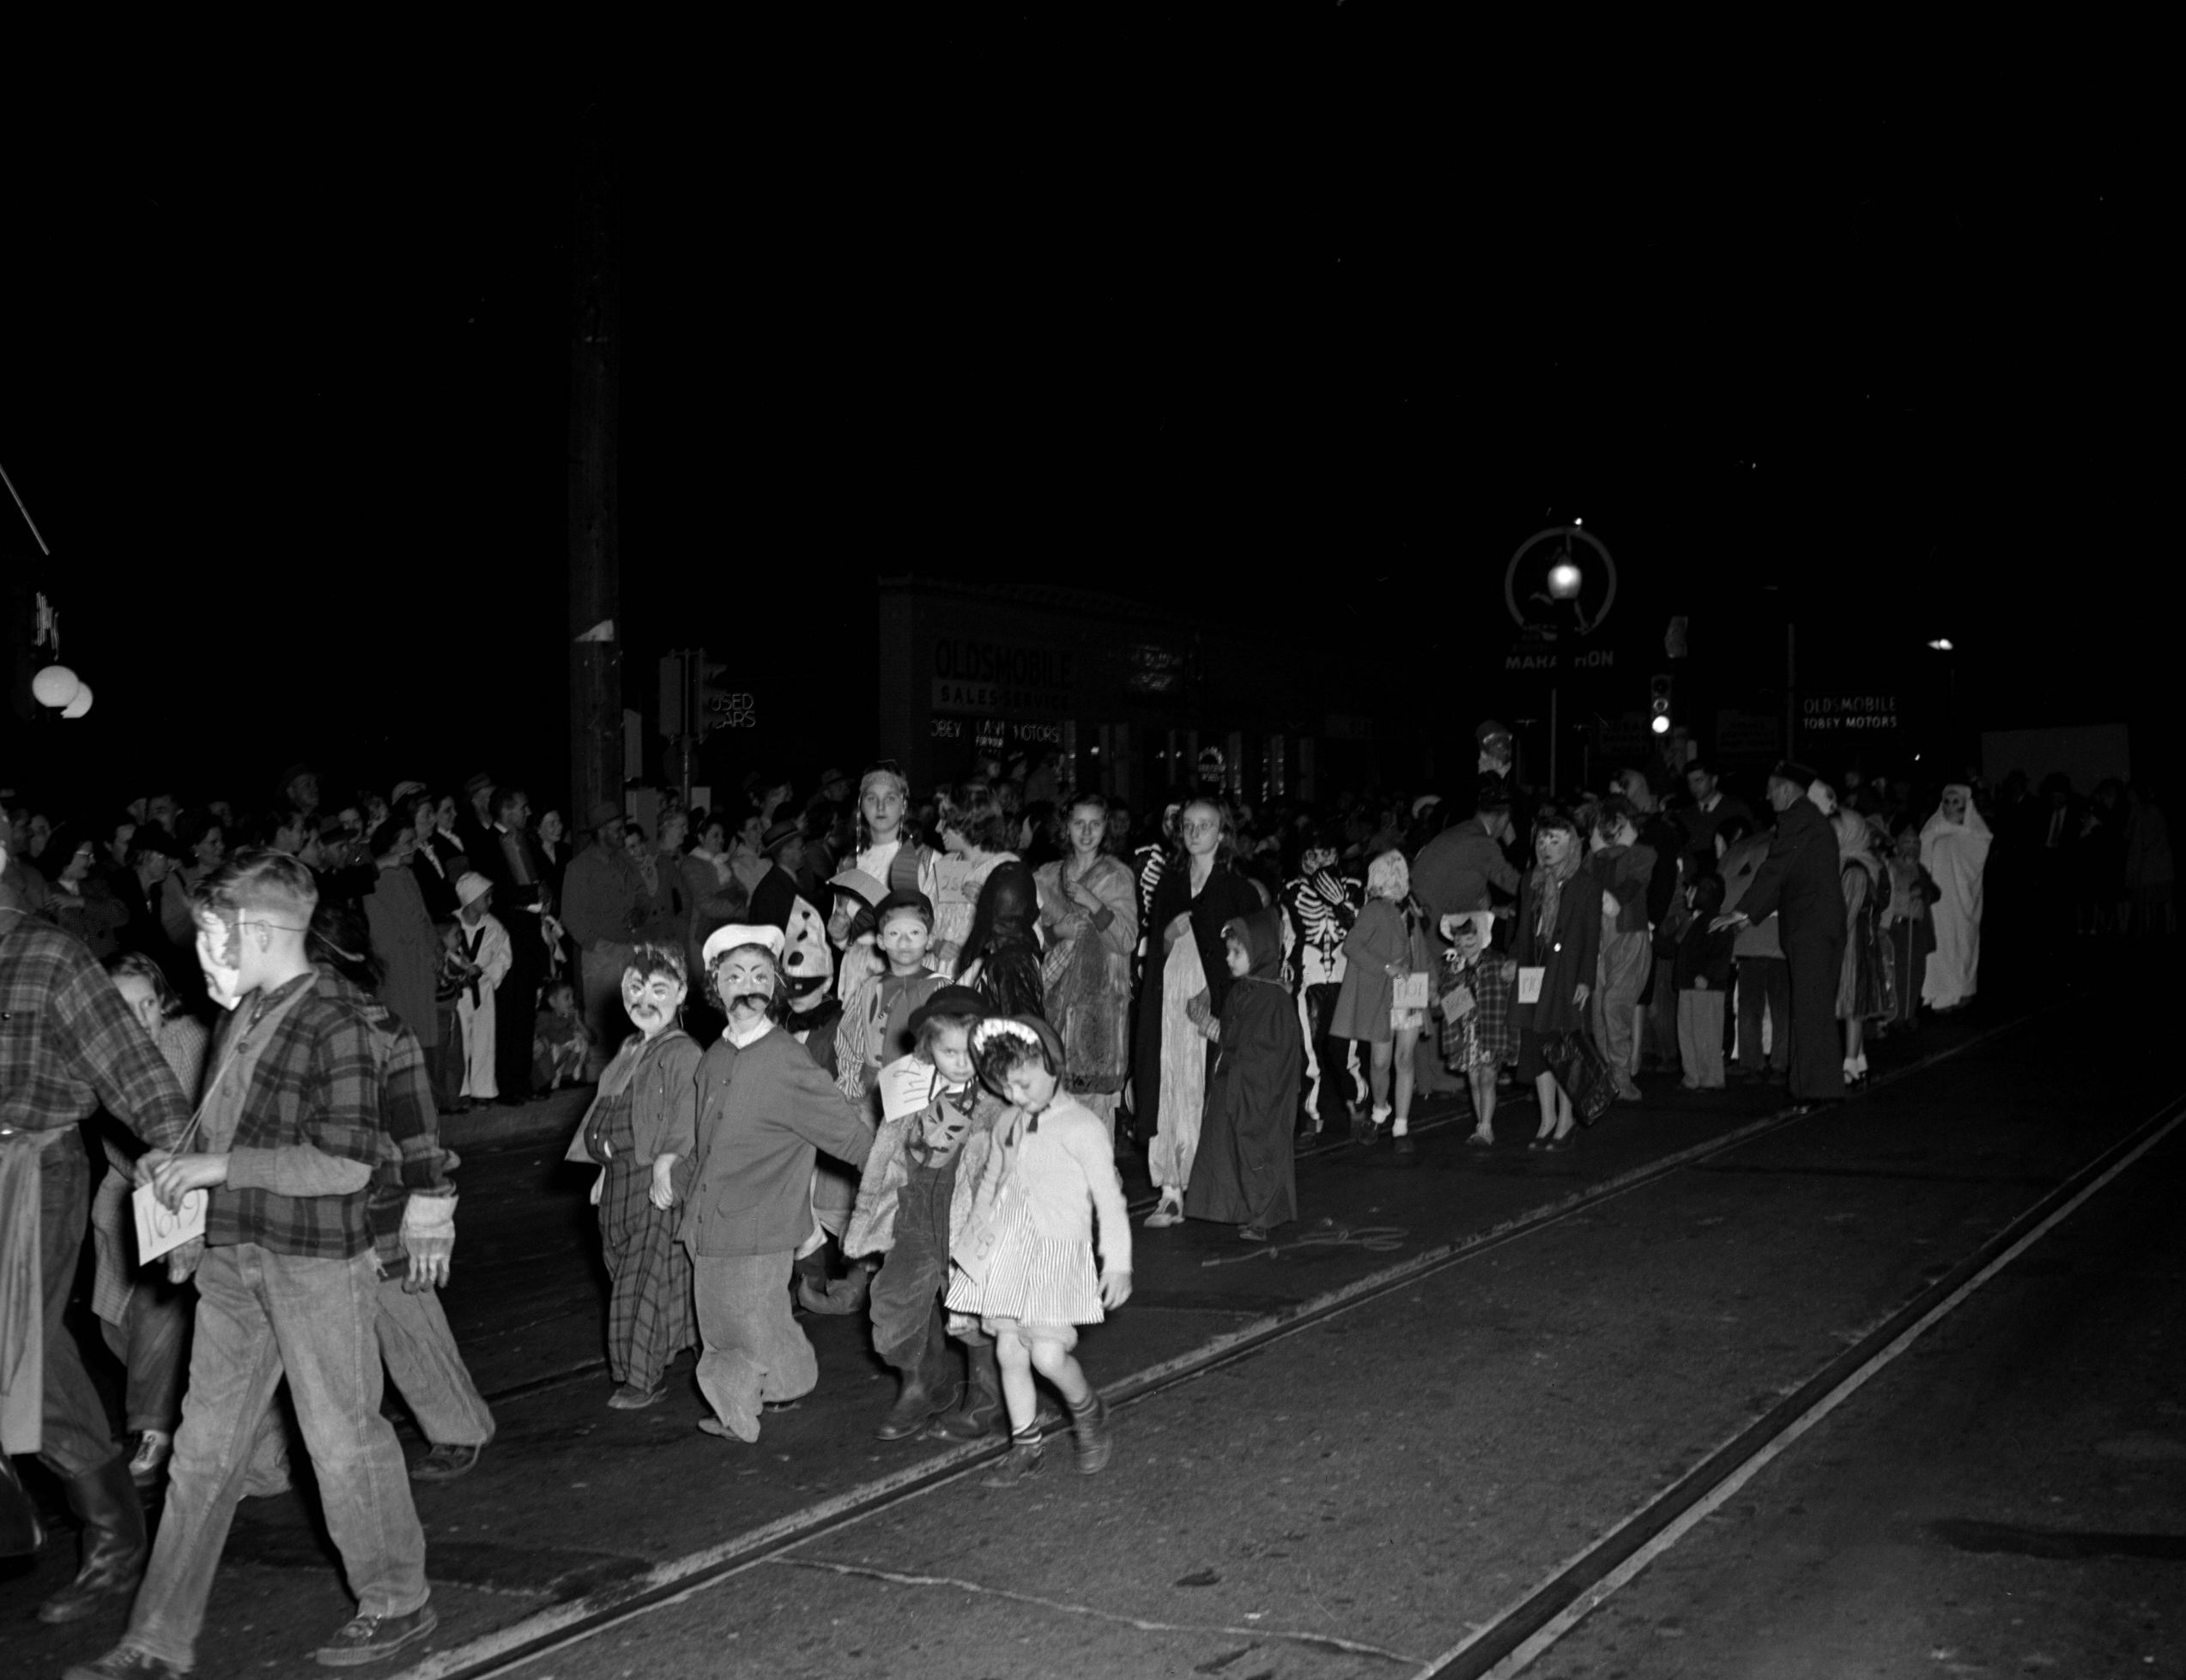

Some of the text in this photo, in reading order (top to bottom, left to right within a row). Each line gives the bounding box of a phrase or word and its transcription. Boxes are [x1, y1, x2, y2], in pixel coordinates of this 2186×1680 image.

[936, 638, 1072, 690] OLDSMOBILE
[1505, 650, 1614, 670] MARAHON
[1803, 696, 1897, 714] OLDSMOBILE
[1803, 714, 1898, 730] TOBEY MOTORS
